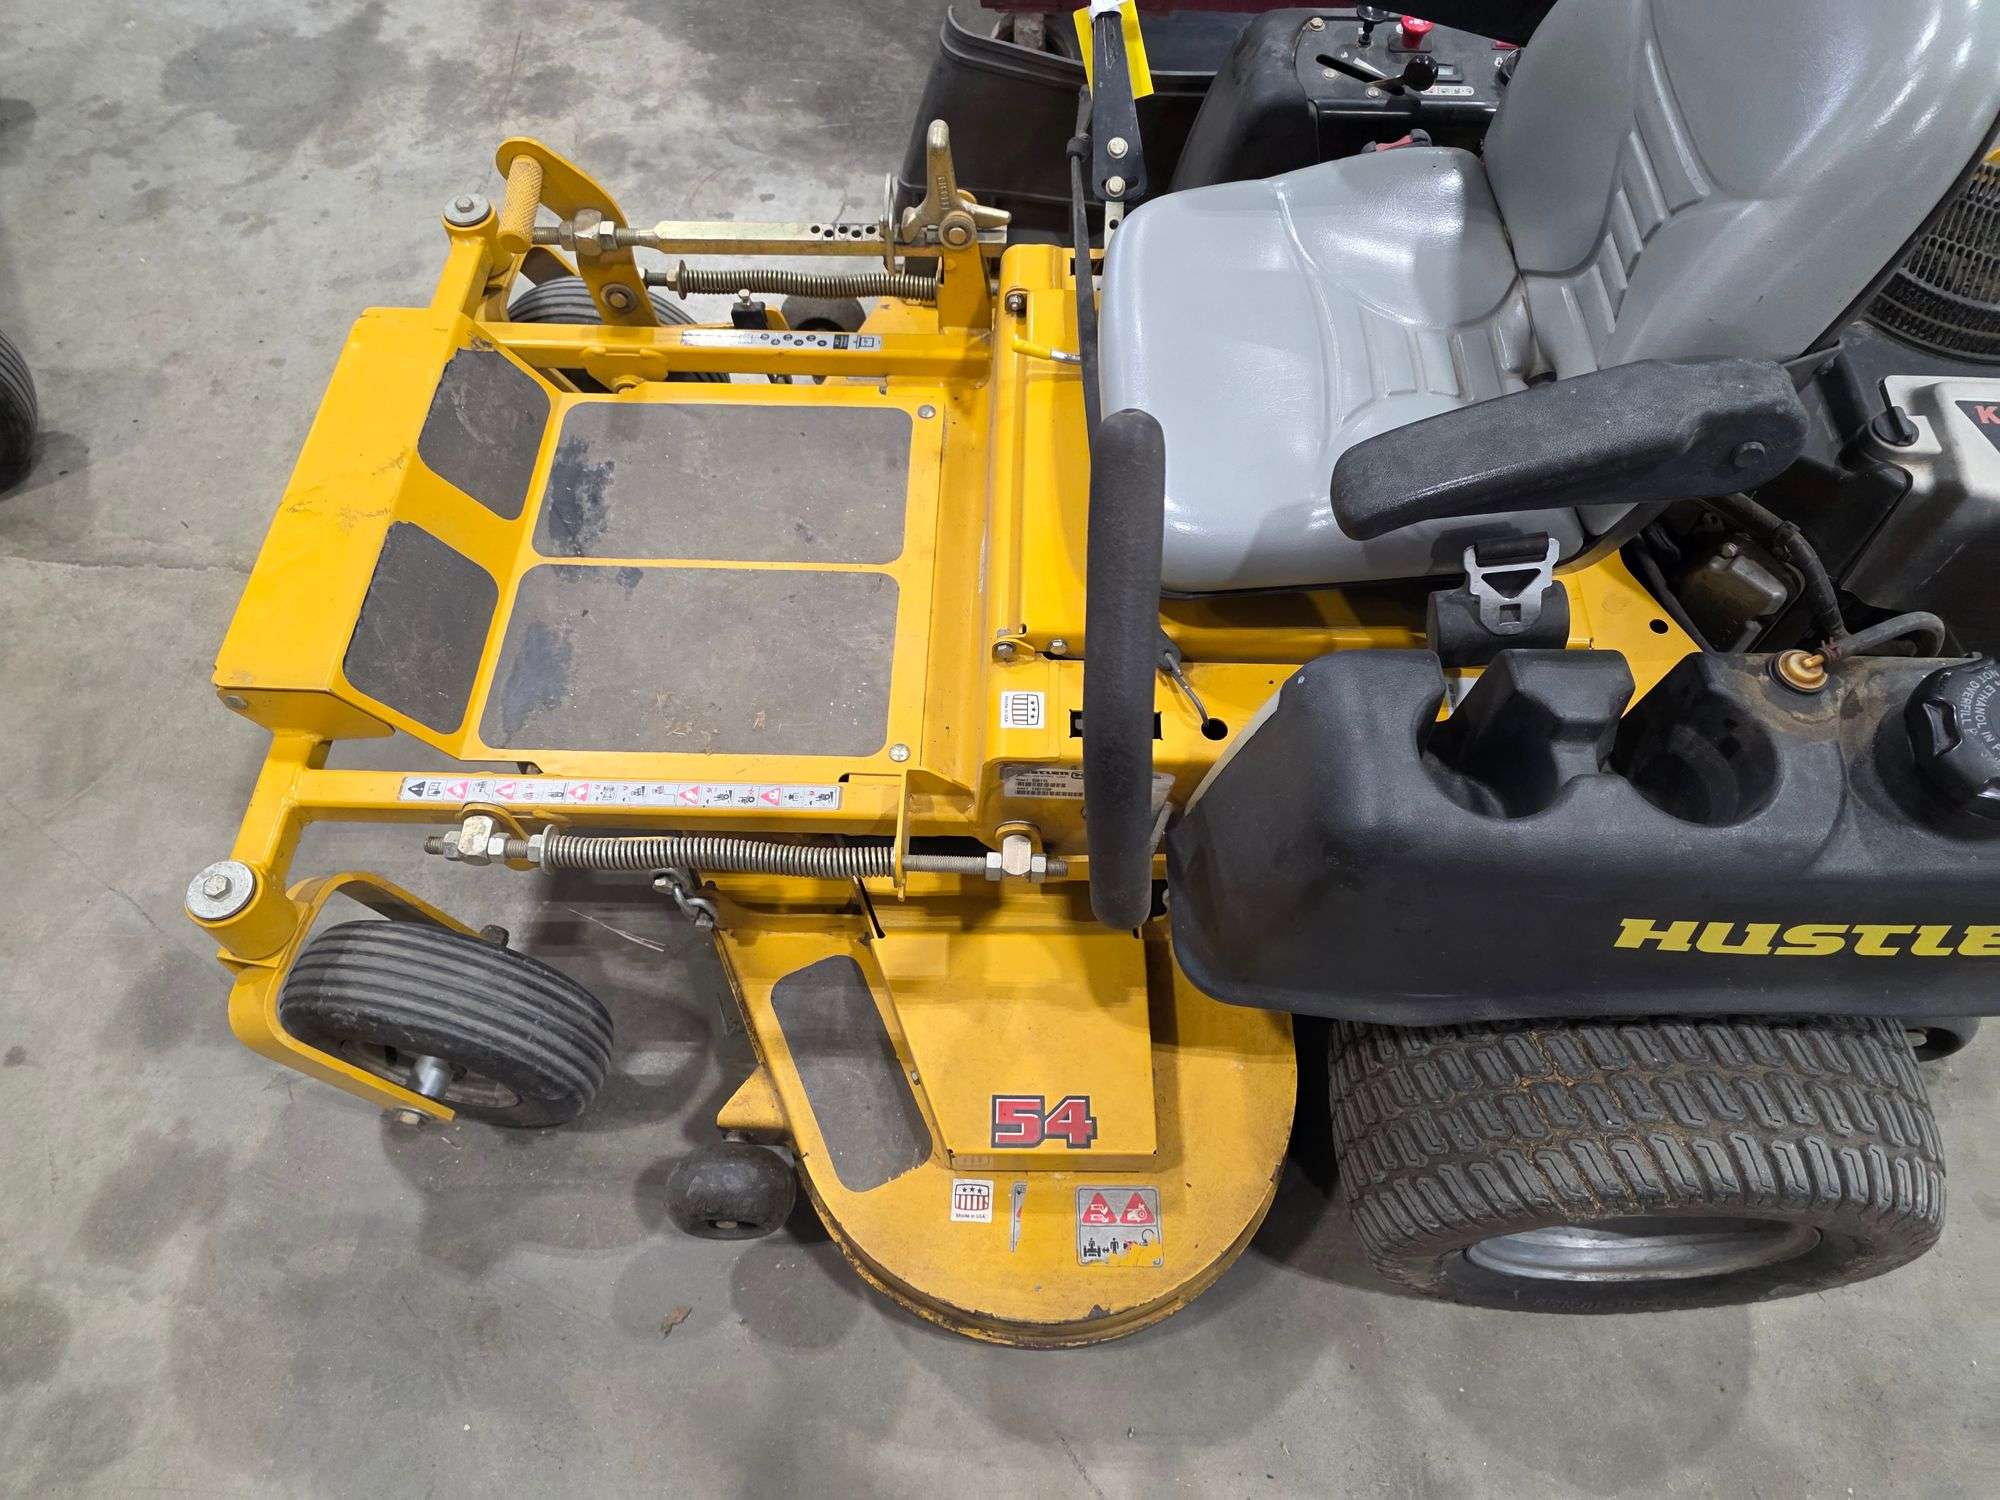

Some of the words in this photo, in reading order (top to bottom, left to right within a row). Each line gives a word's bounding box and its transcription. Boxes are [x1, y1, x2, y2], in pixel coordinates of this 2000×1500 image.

[1960, 680, 1980, 725] OVERFILL
[1974, 684, 1996, 729] ETHANOL
[1981, 731, 1996, 743] IN
[1613, 917, 2000, 957] HUSTLE
[990, 1095, 1098, 1149] 54
